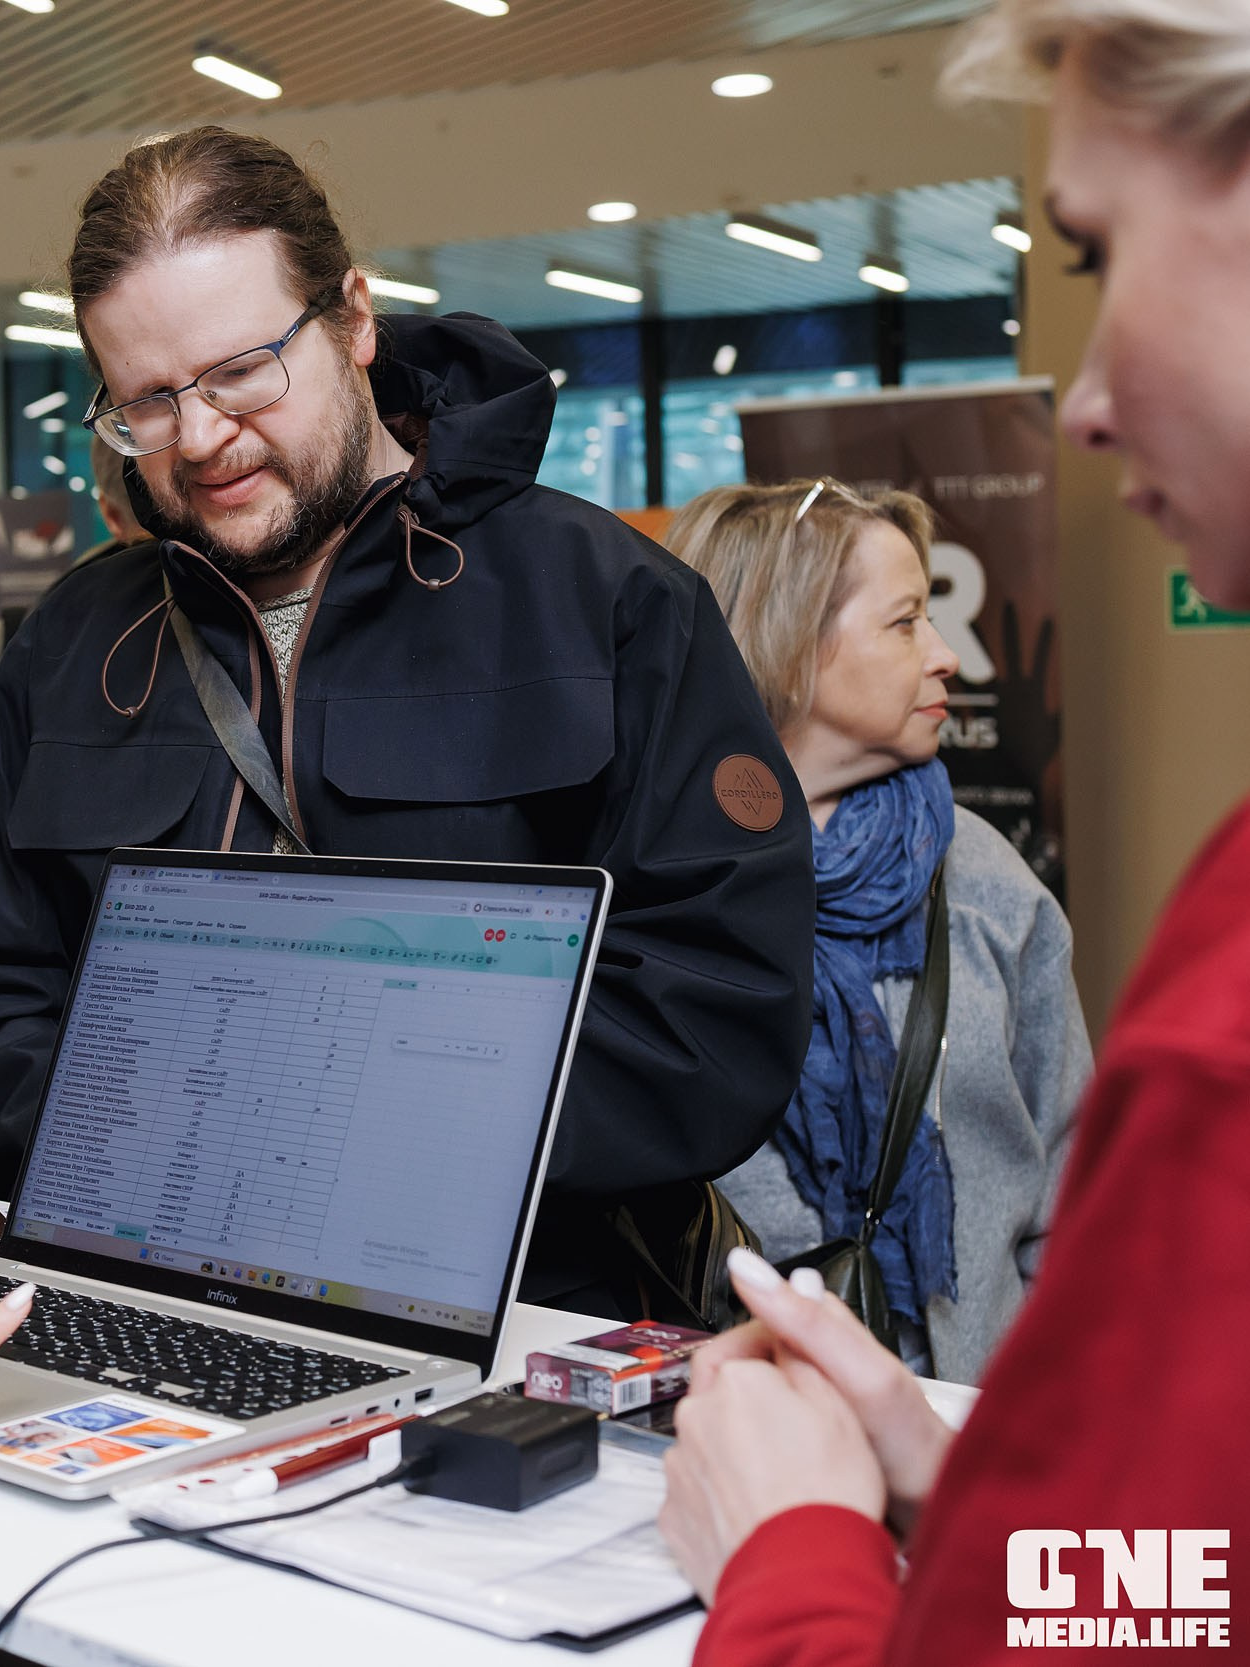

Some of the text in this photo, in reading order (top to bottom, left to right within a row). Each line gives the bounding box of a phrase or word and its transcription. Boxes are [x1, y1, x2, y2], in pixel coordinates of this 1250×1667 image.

[971, 471, 1044, 499] GROUP
[720, 789, 779, 800] CORDILLERO
[109, 1015, 133, 1024] Александр
[78, 1021, 106, 1029] Никифорова
[116, 1036, 149, 1045] Владимировна
[108, 1045, 136, 1053] Викторович
[104, 1065, 138, 1074] Владимирович
[106, 1075, 127, 1083] Юрьевна
[102, 1085, 129, 1094] Николаевна
[104, 1096, 132, 1105] Викторович
[90, 1104, 110, 1112] Светлана
[110, 1107, 137, 1116] Евгеньевна
[84, 1114, 108, 1123] Владимир
[108, 1117, 137, 1127] Михайлович
[89, 1124, 112, 1133] Сергеевна
[206, 1288, 238, 1306] Infinix
[633, 1327, 681, 1341] neo
[531, 1371, 563, 1390] neo
